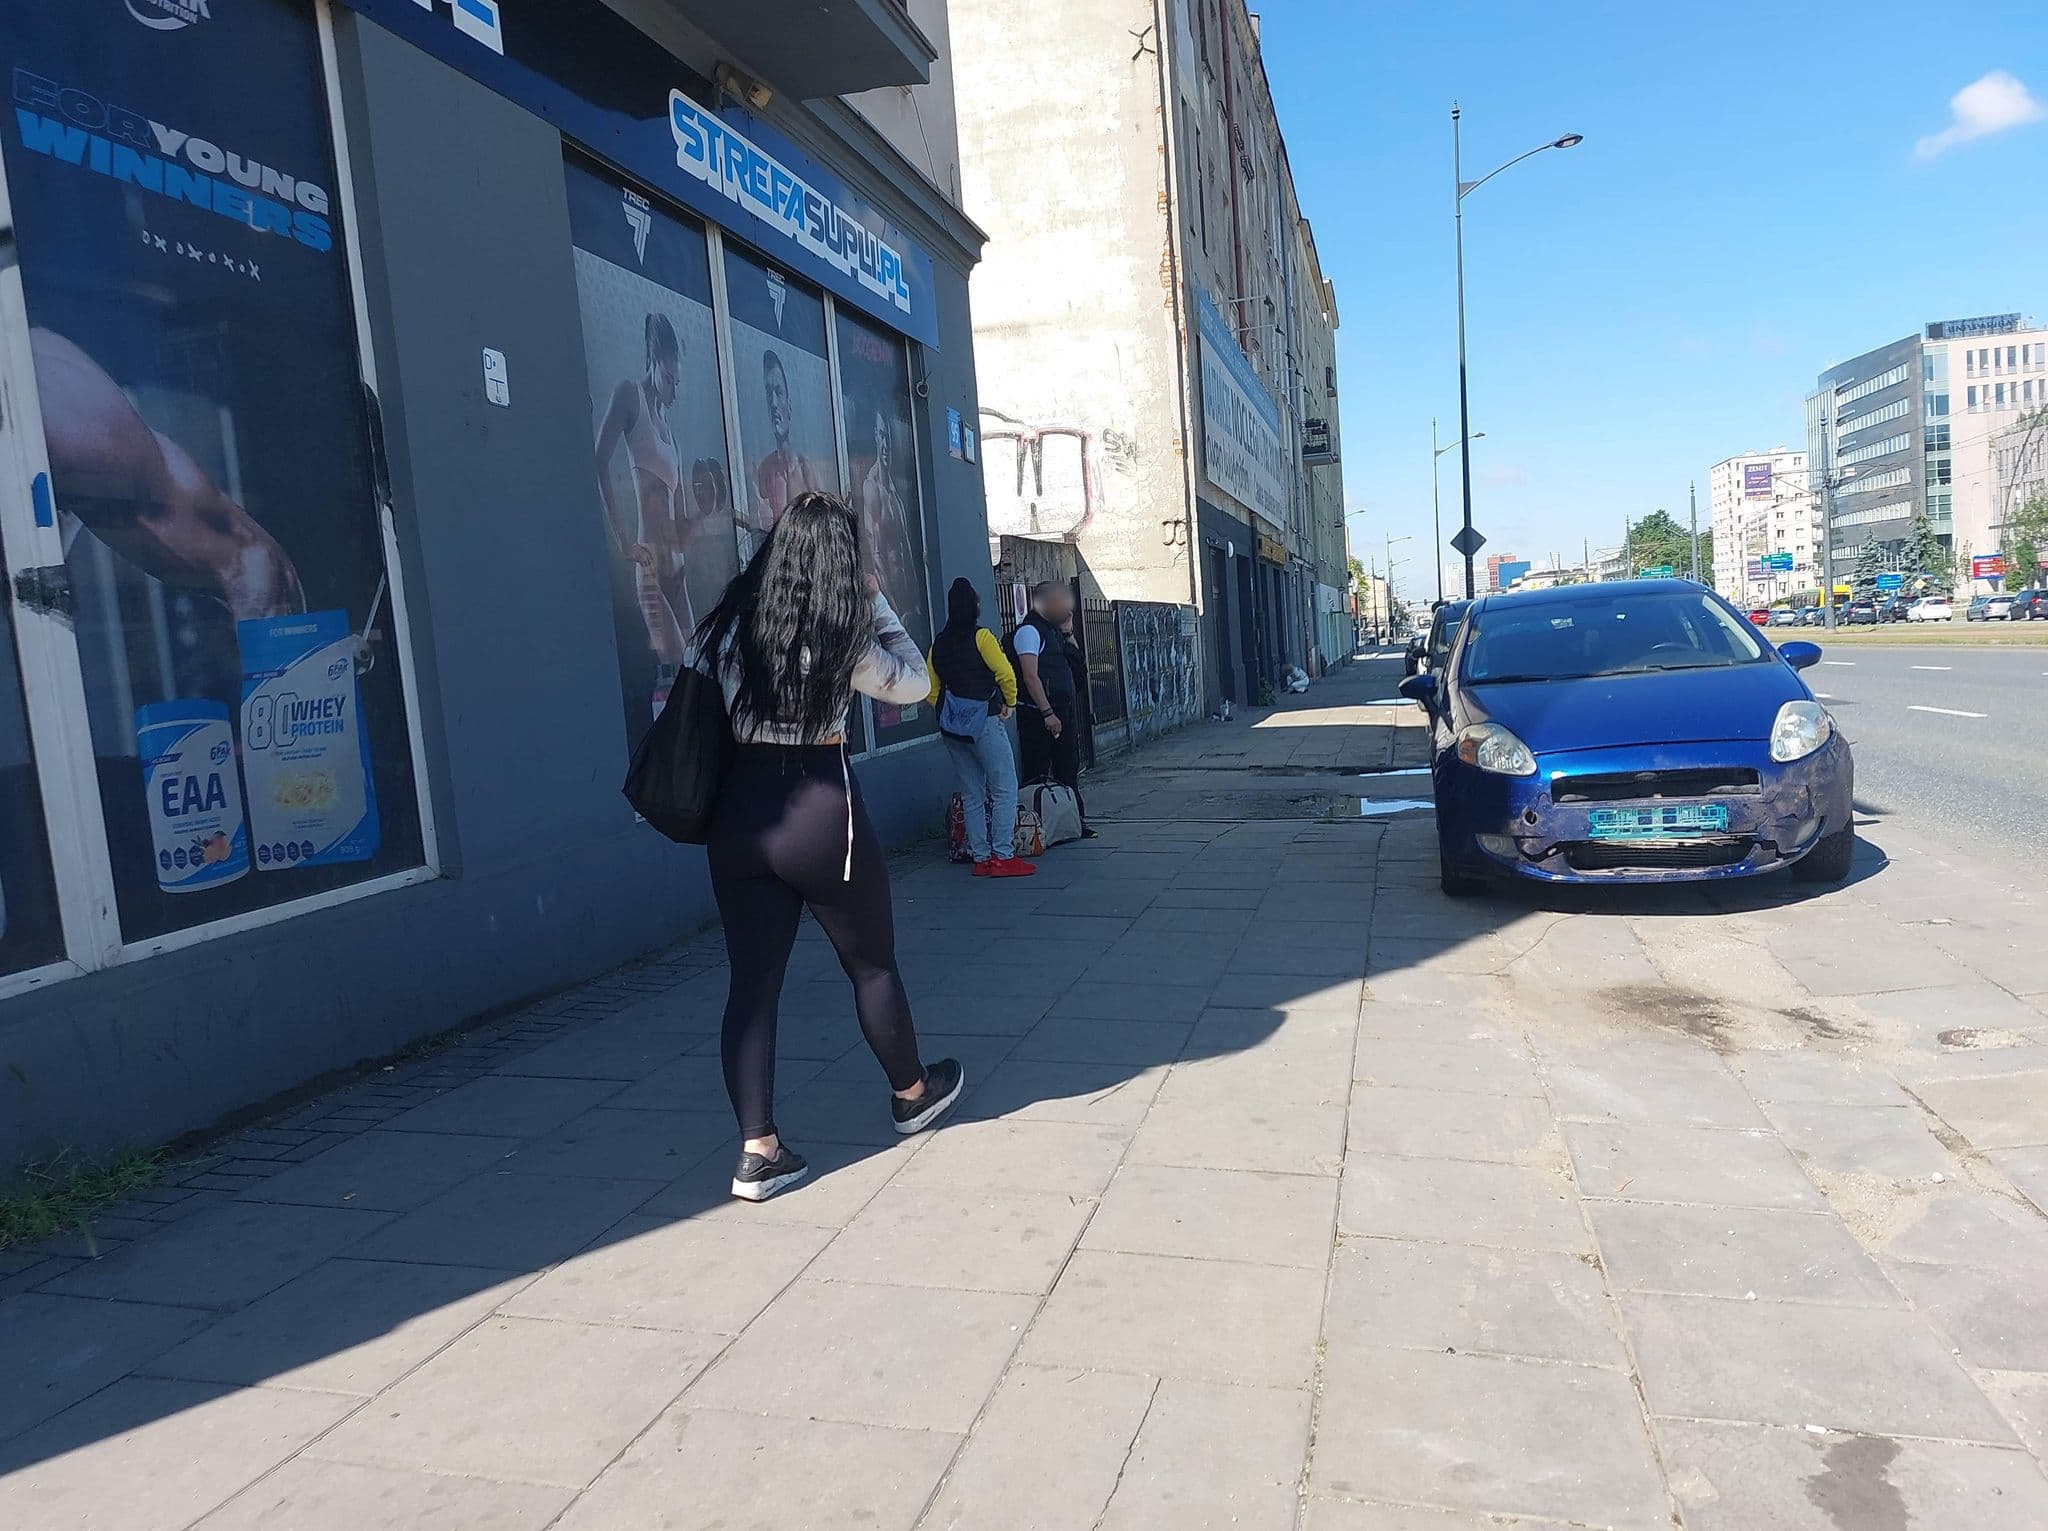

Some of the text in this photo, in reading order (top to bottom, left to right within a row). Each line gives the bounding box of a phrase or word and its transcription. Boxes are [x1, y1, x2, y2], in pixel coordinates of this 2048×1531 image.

[15, 107, 333, 254] WINNERS
[622, 186, 651, 212] TREC
[248, 692, 300, 751] 80
[291, 696, 346, 722] WHEY
[291, 719, 344, 737] PROTEIN
[162, 772, 227, 817] EAA
